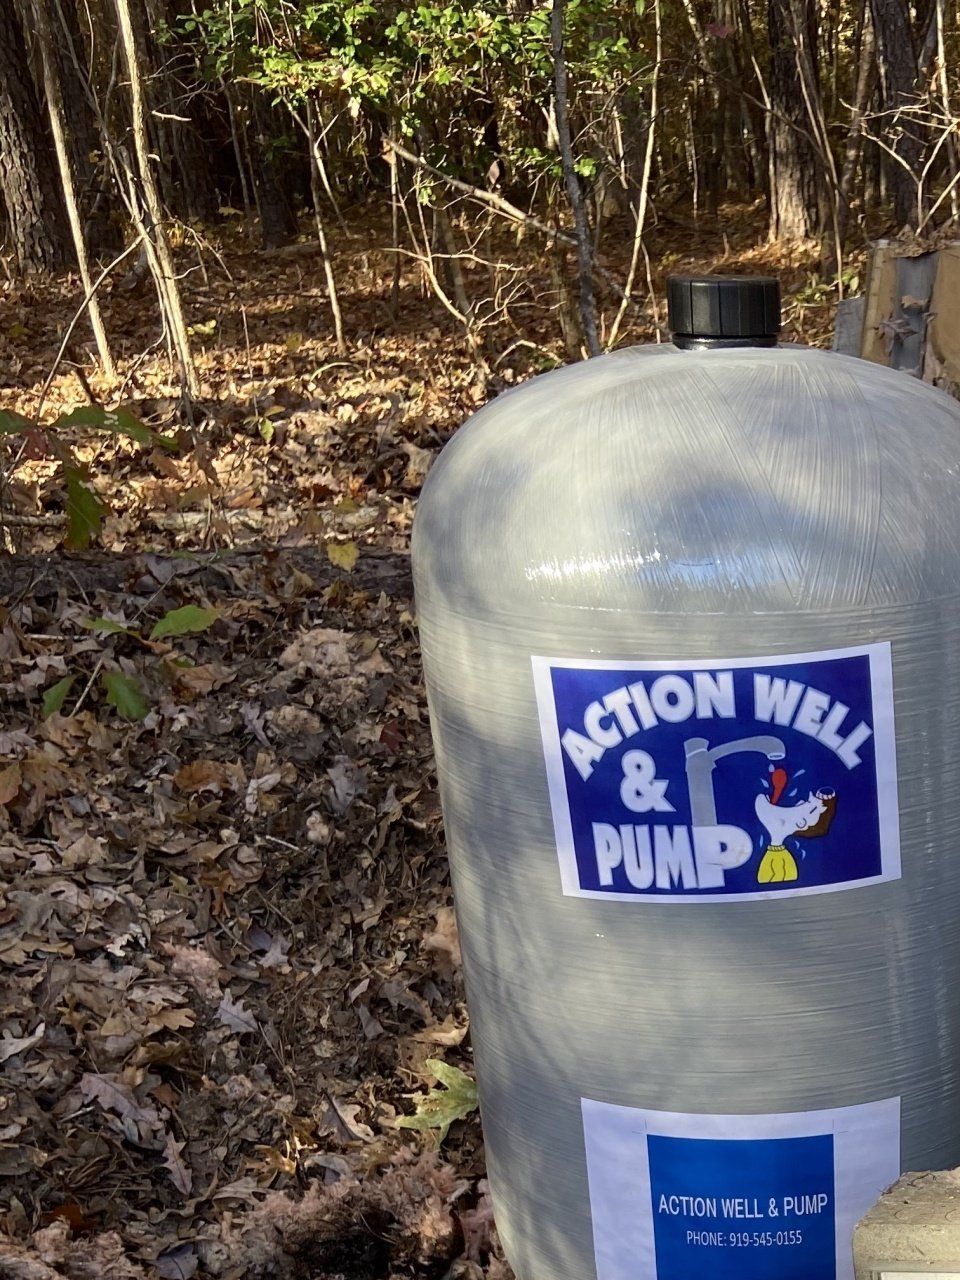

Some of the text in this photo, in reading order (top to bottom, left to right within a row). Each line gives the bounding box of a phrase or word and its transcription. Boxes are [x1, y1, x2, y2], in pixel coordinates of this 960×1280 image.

[561, 671, 874, 782] ACTION WELL
[620, 749, 676, 813] &
[592, 822, 754, 890] PUMP
[658, 1193, 828, 1219] ACTION WELL & PUMP
[686, 1230, 802, 1247] PHONE: 919-545-0155
